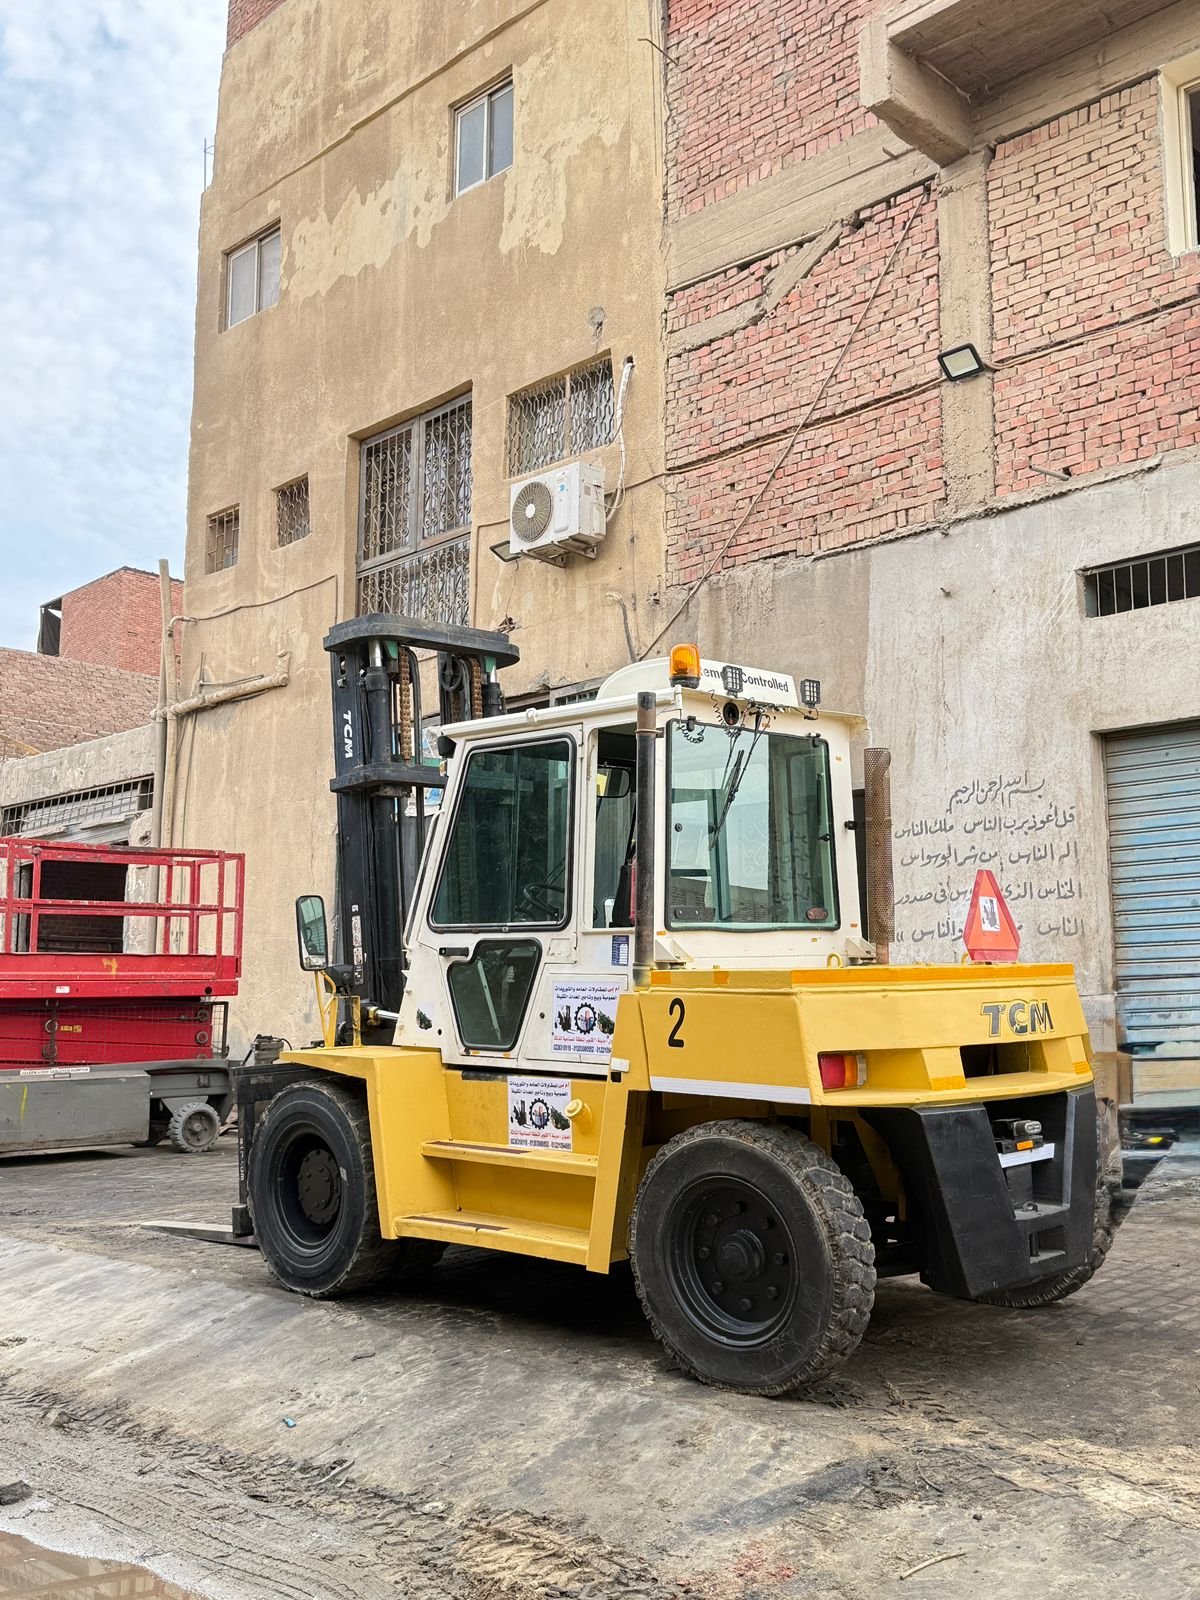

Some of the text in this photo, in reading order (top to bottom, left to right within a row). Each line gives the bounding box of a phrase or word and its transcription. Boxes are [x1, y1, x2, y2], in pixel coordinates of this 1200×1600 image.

[741, 672, 789, 692] Controlled
[343, 709, 354, 759] TCM
[1003, 769, 1028, 790] الله
[948, 779, 980, 814] الرحيم
[1008, 778, 1046, 808] بسم
[928, 818, 954, 834] ملك
[963, 815, 1002, 833] الناس
[1003, 819, 1029, 835] برب
[1055, 806, 1076, 828] قل
[894, 820, 929, 839] الناس
[901, 844, 958, 868] الوسواس
[957, 845, 978, 867] شر
[979, 850, 998, 863] من
[1008, 842, 1055, 864] الناس
[894, 890, 933, 906] صدور
[1037, 877, 1083, 900] الخناس
[1037, 916, 1086, 942] الناس
[668, 997, 685, 1048] 2
[981, 1000, 1055, 1036] TCM
